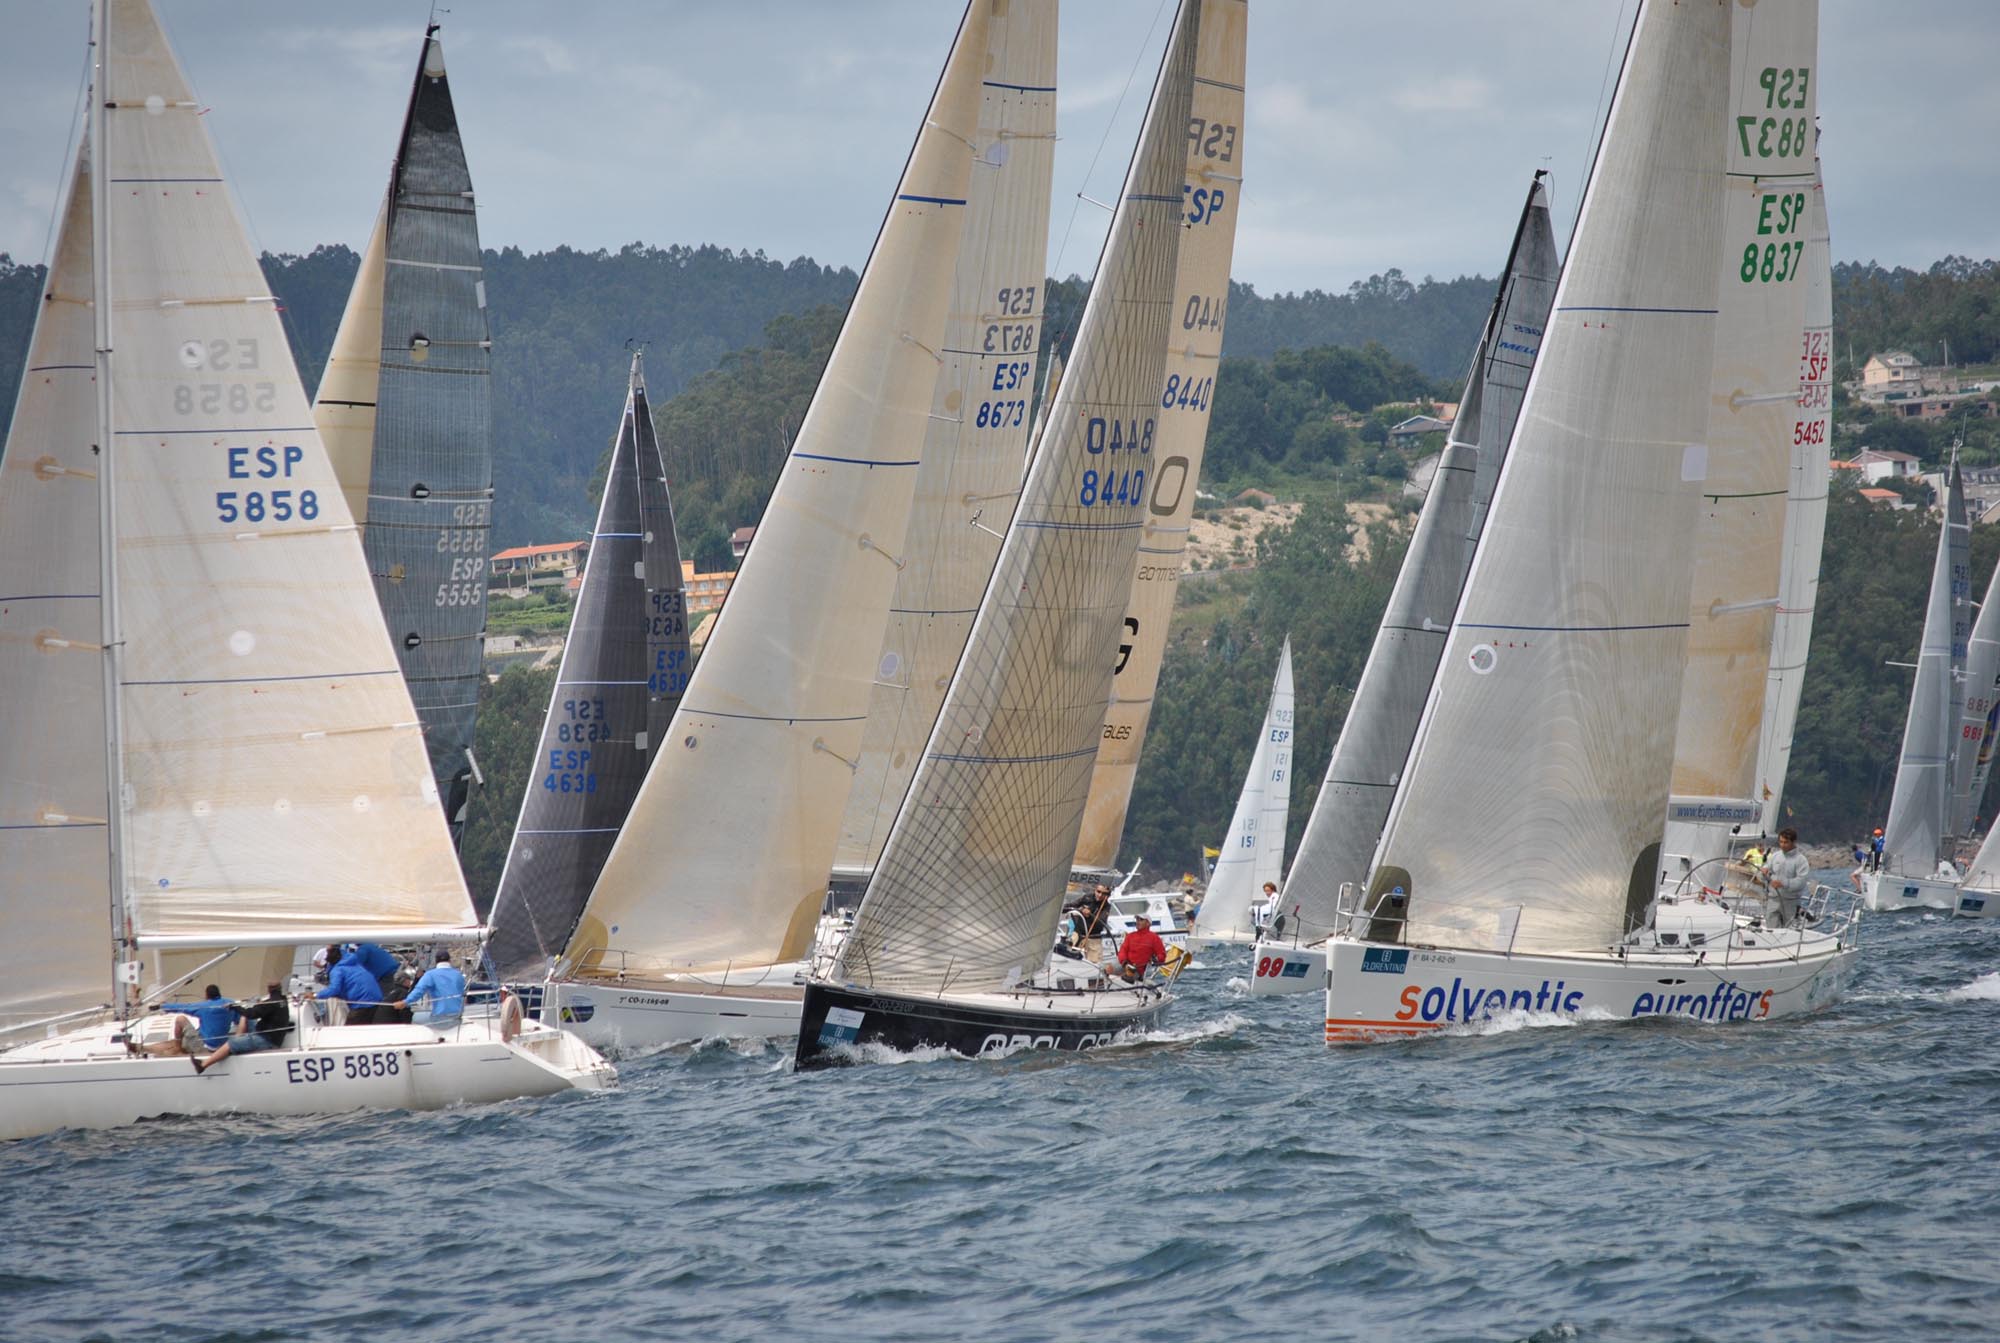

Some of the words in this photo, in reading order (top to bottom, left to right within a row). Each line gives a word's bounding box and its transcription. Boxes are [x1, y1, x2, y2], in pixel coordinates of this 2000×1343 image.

[1757, 193, 1805, 235] ESP
[1740, 241, 1804, 283] 8837
[992, 362, 1030, 391] ESP
[1162, 374, 1212, 411] 8440
[976, 400, 1025, 428] 8673
[1794, 420, 1825, 445] 5452
[228, 446, 303, 479] ESP
[1080, 469, 1144, 507] 8440
[216, 490, 319, 523] 5858
[450, 557, 484, 581] ESP
[435, 583, 482, 607] 5555
[656, 650, 686, 671] ESP
[1271, 730, 1289, 743] ESP
[550, 750, 591, 770] ESP
[543, 773, 597, 794] 4638
[1271, 770, 1285, 782] 151
[1241, 836, 1256, 848] 151
[1256, 957, 1284, 977] 99
[1363, 960, 1405, 973] FLORENTINO
[287, 1058, 334, 1084] ESP
[344, 1051, 400, 1079] 5858
